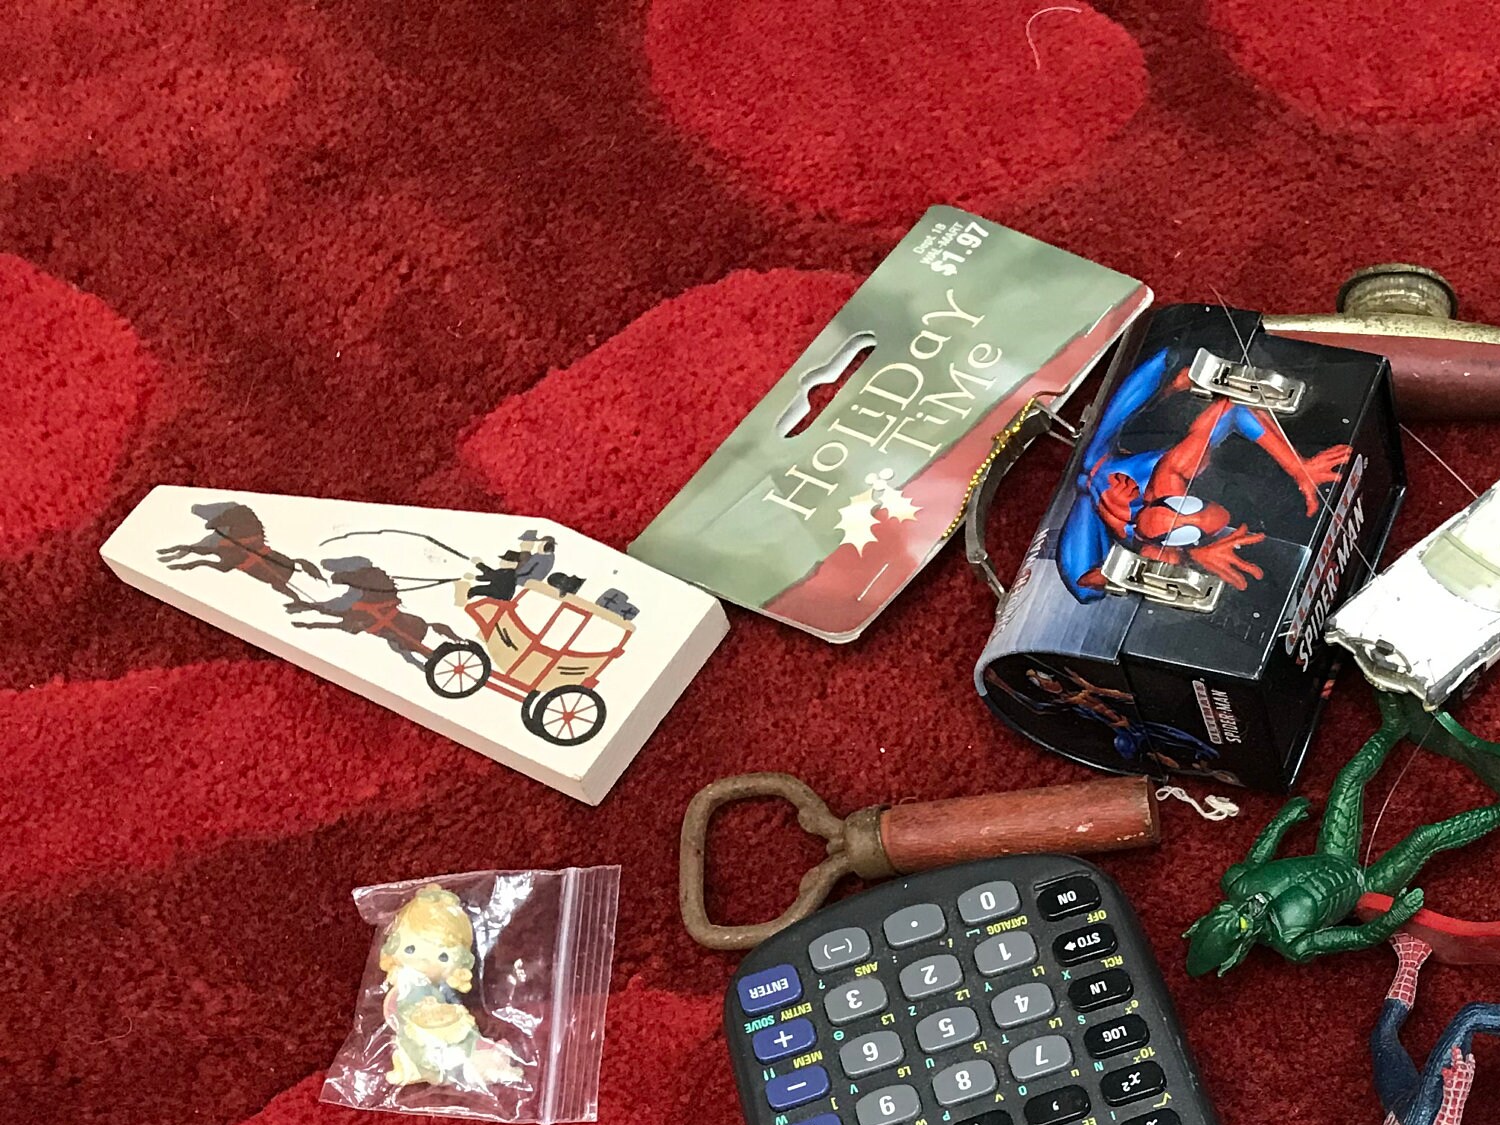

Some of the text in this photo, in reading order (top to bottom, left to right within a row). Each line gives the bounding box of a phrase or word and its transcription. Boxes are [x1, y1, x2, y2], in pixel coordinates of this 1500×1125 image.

[931, 221, 989, 276] $1.97
[1299, 497, 1365, 672] SPIDER-MAN
[1211, 689, 1242, 744] SPIDER-MAN
[979, 890, 996, 911] 0
[1057, 889, 1077, 905] ON
[986, 914, 1028, 935] CATALOG
[1086, 908, 1107, 923] OFF
[998, 941, 1012, 961] 1
[854, 961, 878, 977] ANS
[920, 964, 938, 985] 2
[1060, 954, 1124, 981] RCL X
[748, 977, 789, 999] ENTER
[983, 965, 1045, 992] L1 Y
[1088, 980, 1107, 995] LN
[845, 989, 863, 1009] 3
[907, 988, 970, 1017] L2 Z
[1013, 994, 1029, 1014] 4
[744, 1001, 813, 1034] ENTRY SOLVE
[880, 1013, 895, 1026] L3
[938, 1017, 956, 1038] 5
[1077, 1014, 1086, 1025] S
[1000, 1016, 1063, 1044] L4 T
[1101, 1025, 1128, 1043] LOG
[793, 1050, 823, 1069] MEM
[862, 1041, 879, 1062] 6
[925, 1040, 988, 1069] L5 U
[1035, 1044, 1049, 1066] 7
[897, 1065, 911, 1078] L6
[1093, 1061, 1104, 1072] N
[955, 1070, 972, 1091] 8
[878, 1095, 896, 1116] 9
[942, 1110, 951, 1121] P
